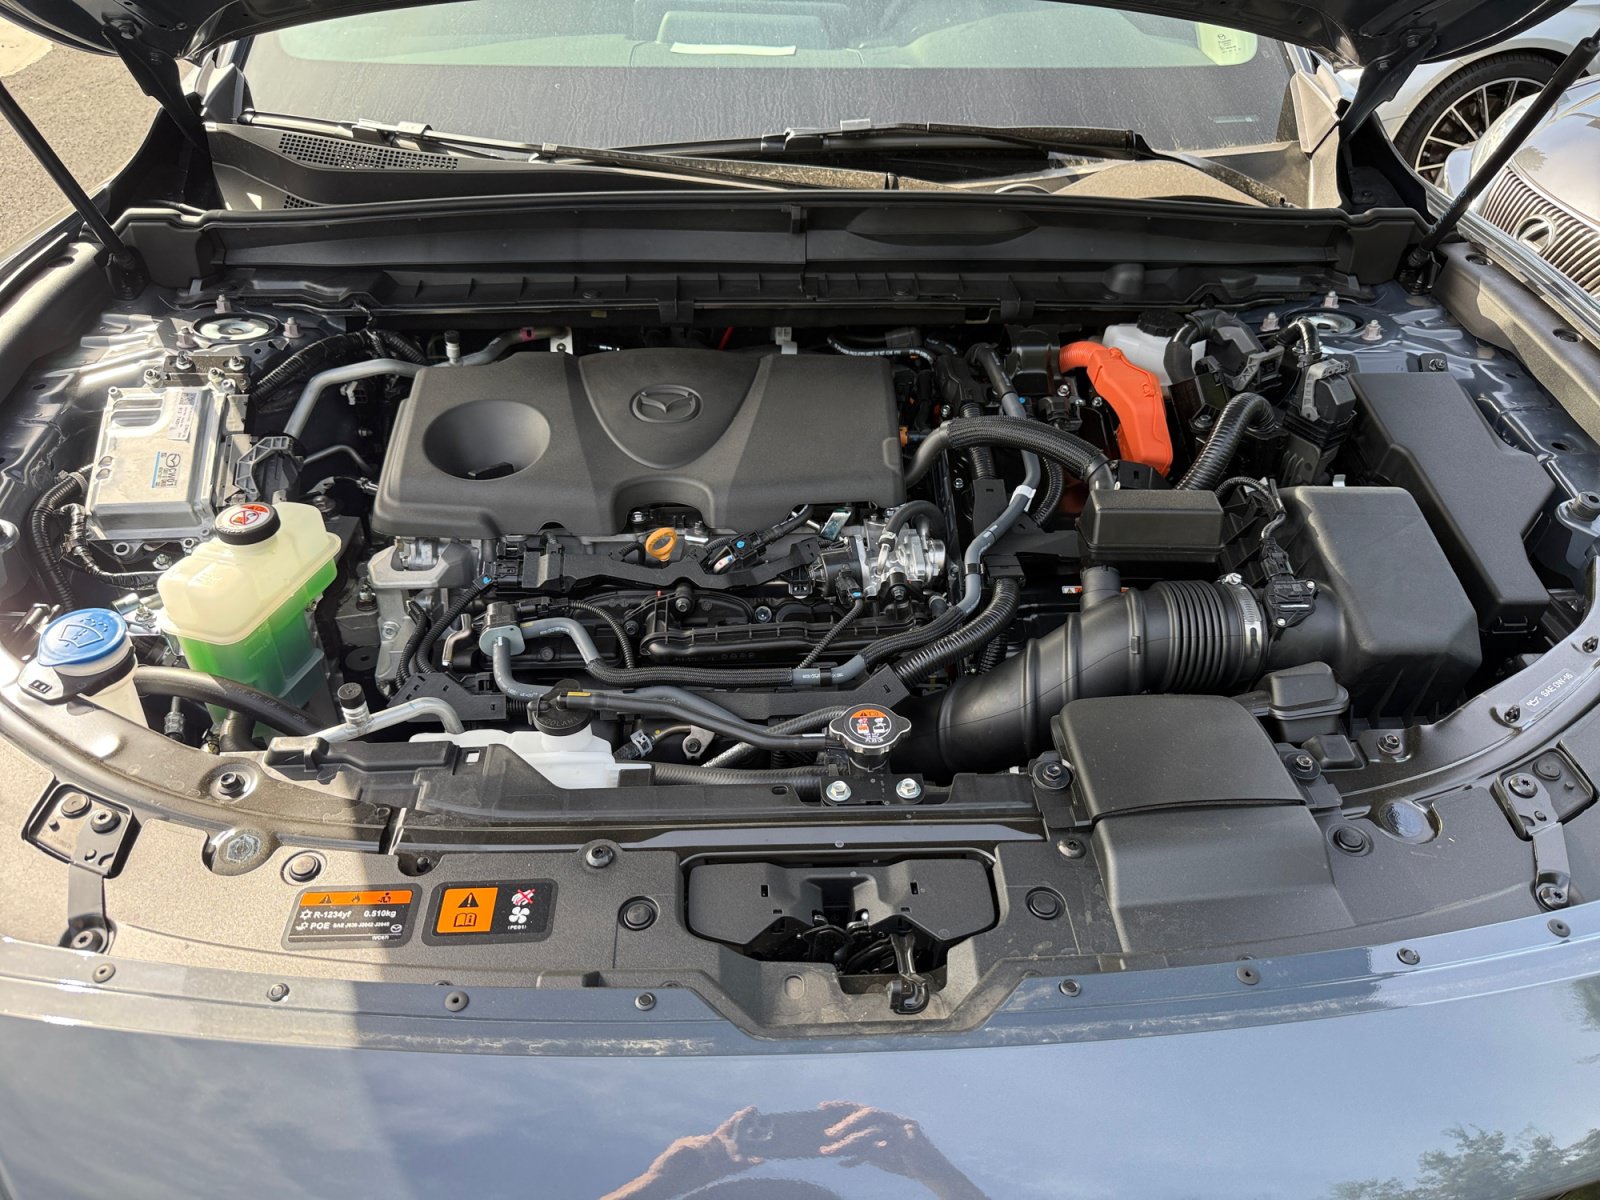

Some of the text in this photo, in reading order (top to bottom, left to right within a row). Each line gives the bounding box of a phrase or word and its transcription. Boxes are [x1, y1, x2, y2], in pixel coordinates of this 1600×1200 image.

[1540, 685, 1556, 696] SAE
[314, 910, 397, 919] R-1234yf 0.510kg
